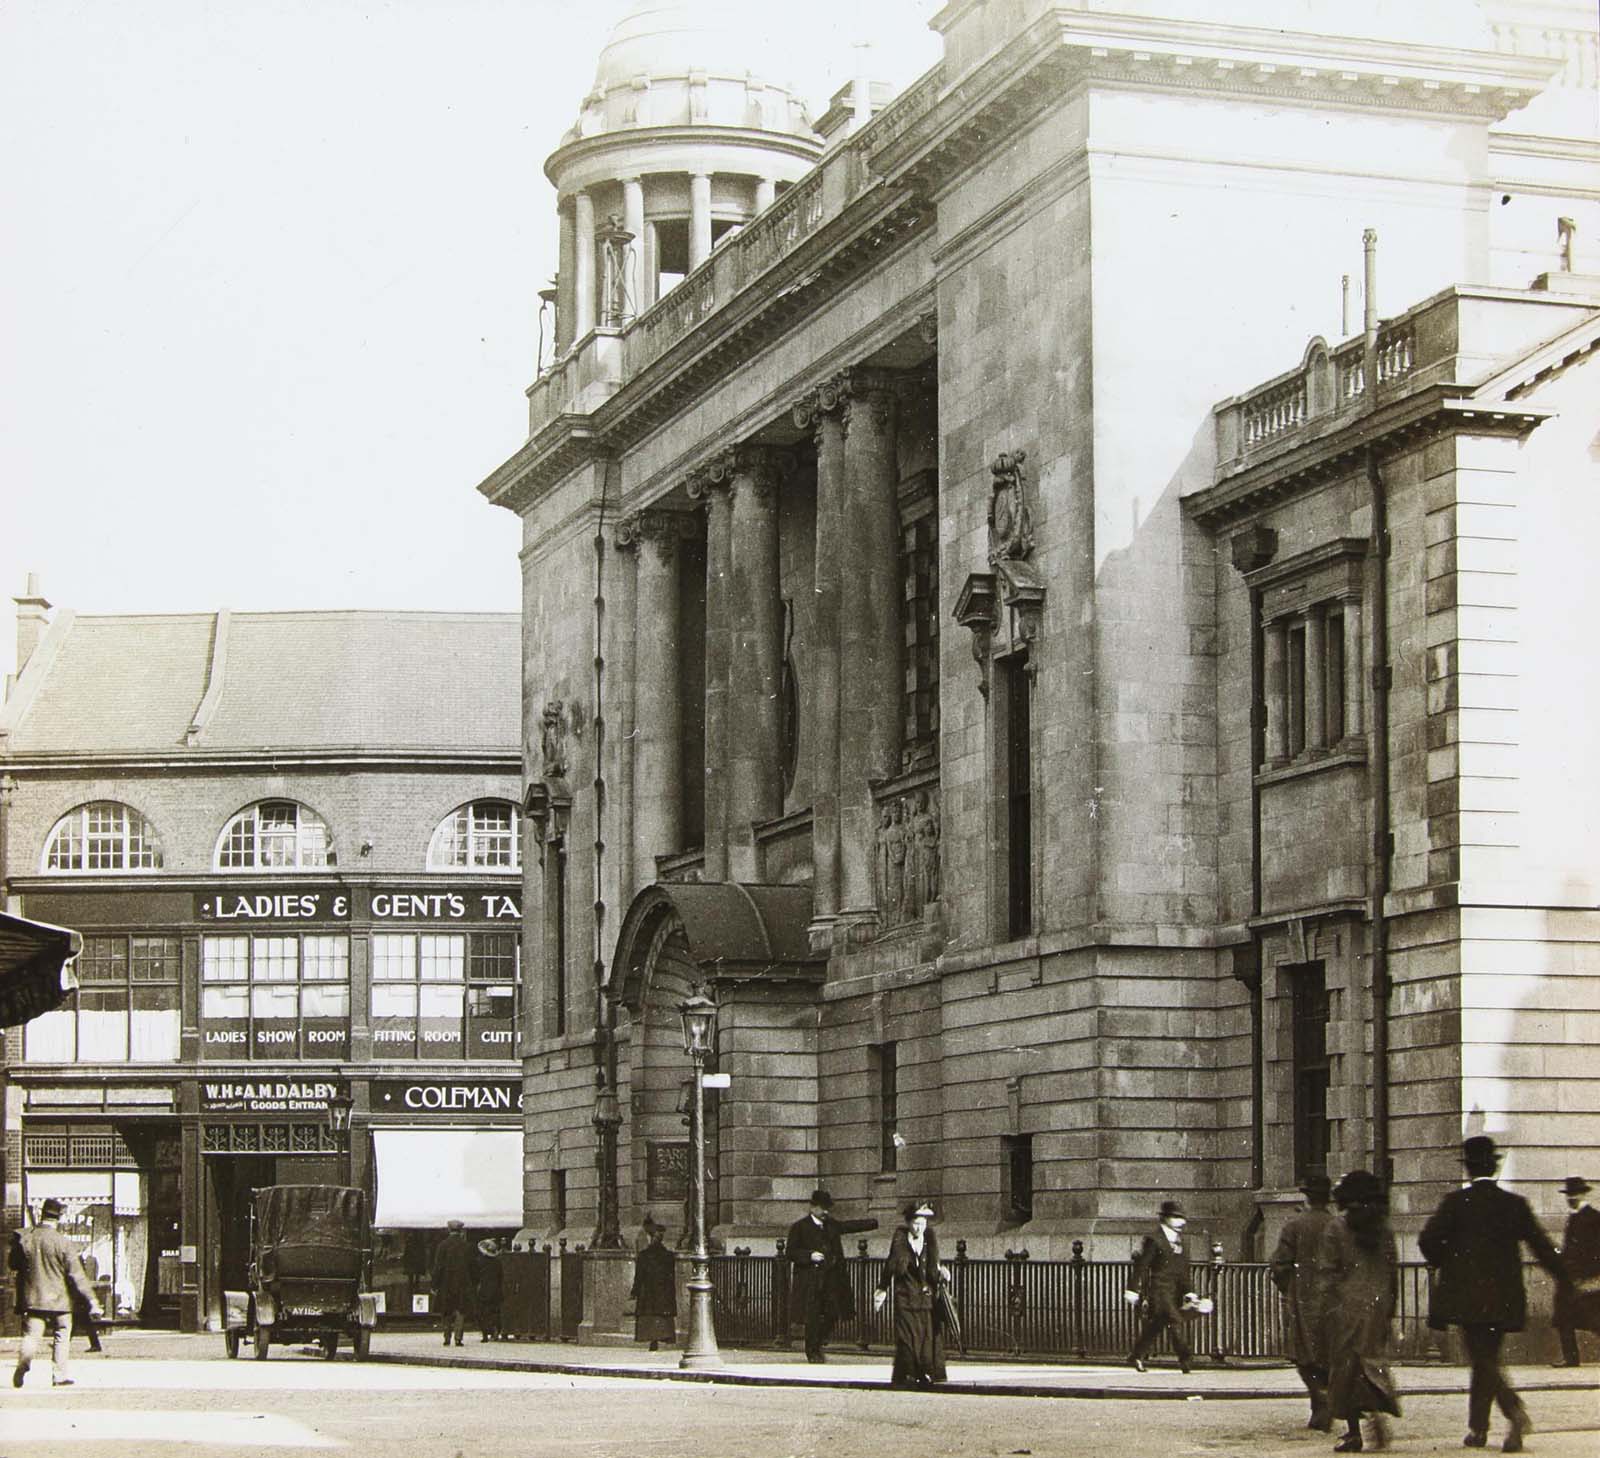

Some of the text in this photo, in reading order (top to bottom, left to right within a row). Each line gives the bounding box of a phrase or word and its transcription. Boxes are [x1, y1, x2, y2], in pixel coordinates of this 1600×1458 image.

[215, 893, 522, 918] LADIES' & GENT'S TA
[257, 1030, 297, 1043] SHOW
[308, 1030, 347, 1043] ROOM
[374, 1030, 462, 1043] FITTING ROOM
[404, 1086, 511, 1109] COLEMAN
[250, 1100, 287, 1110] GOODS
